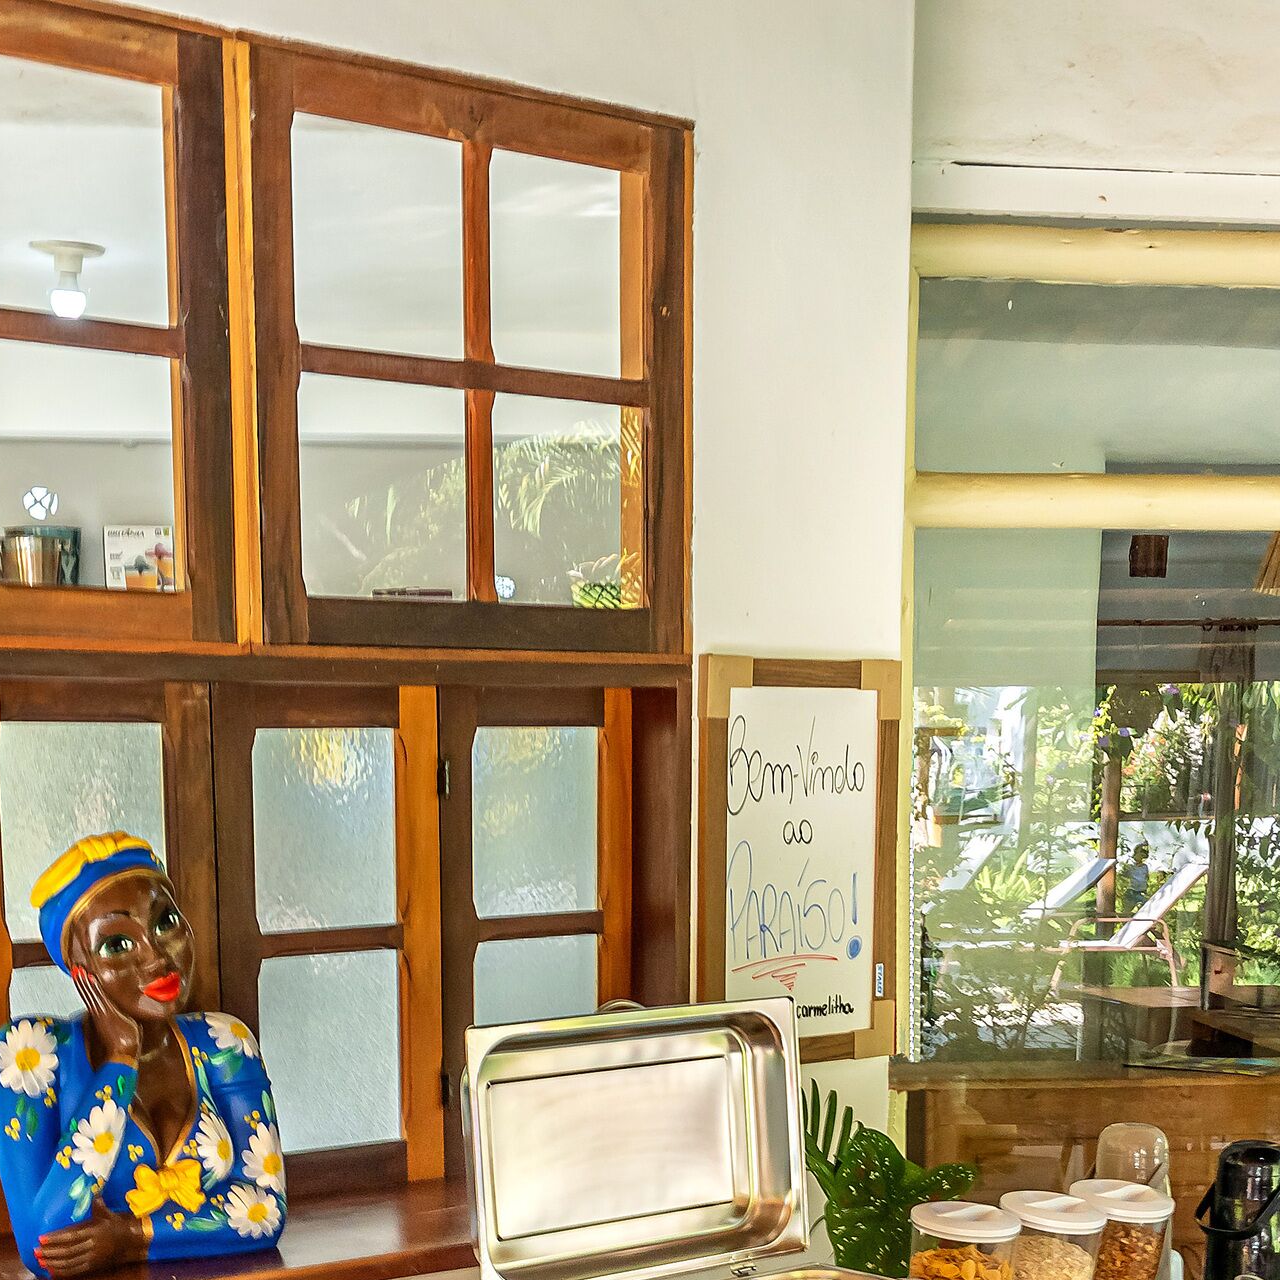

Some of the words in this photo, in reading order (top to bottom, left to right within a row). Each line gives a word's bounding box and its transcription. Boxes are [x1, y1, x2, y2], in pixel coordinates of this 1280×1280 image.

[727, 715, 865, 816] Bem-Vindo
[783, 819, 813, 845] ao
[726, 840, 863, 960] PARAÍSO!
[796, 994, 854, 1019] carmelitha
